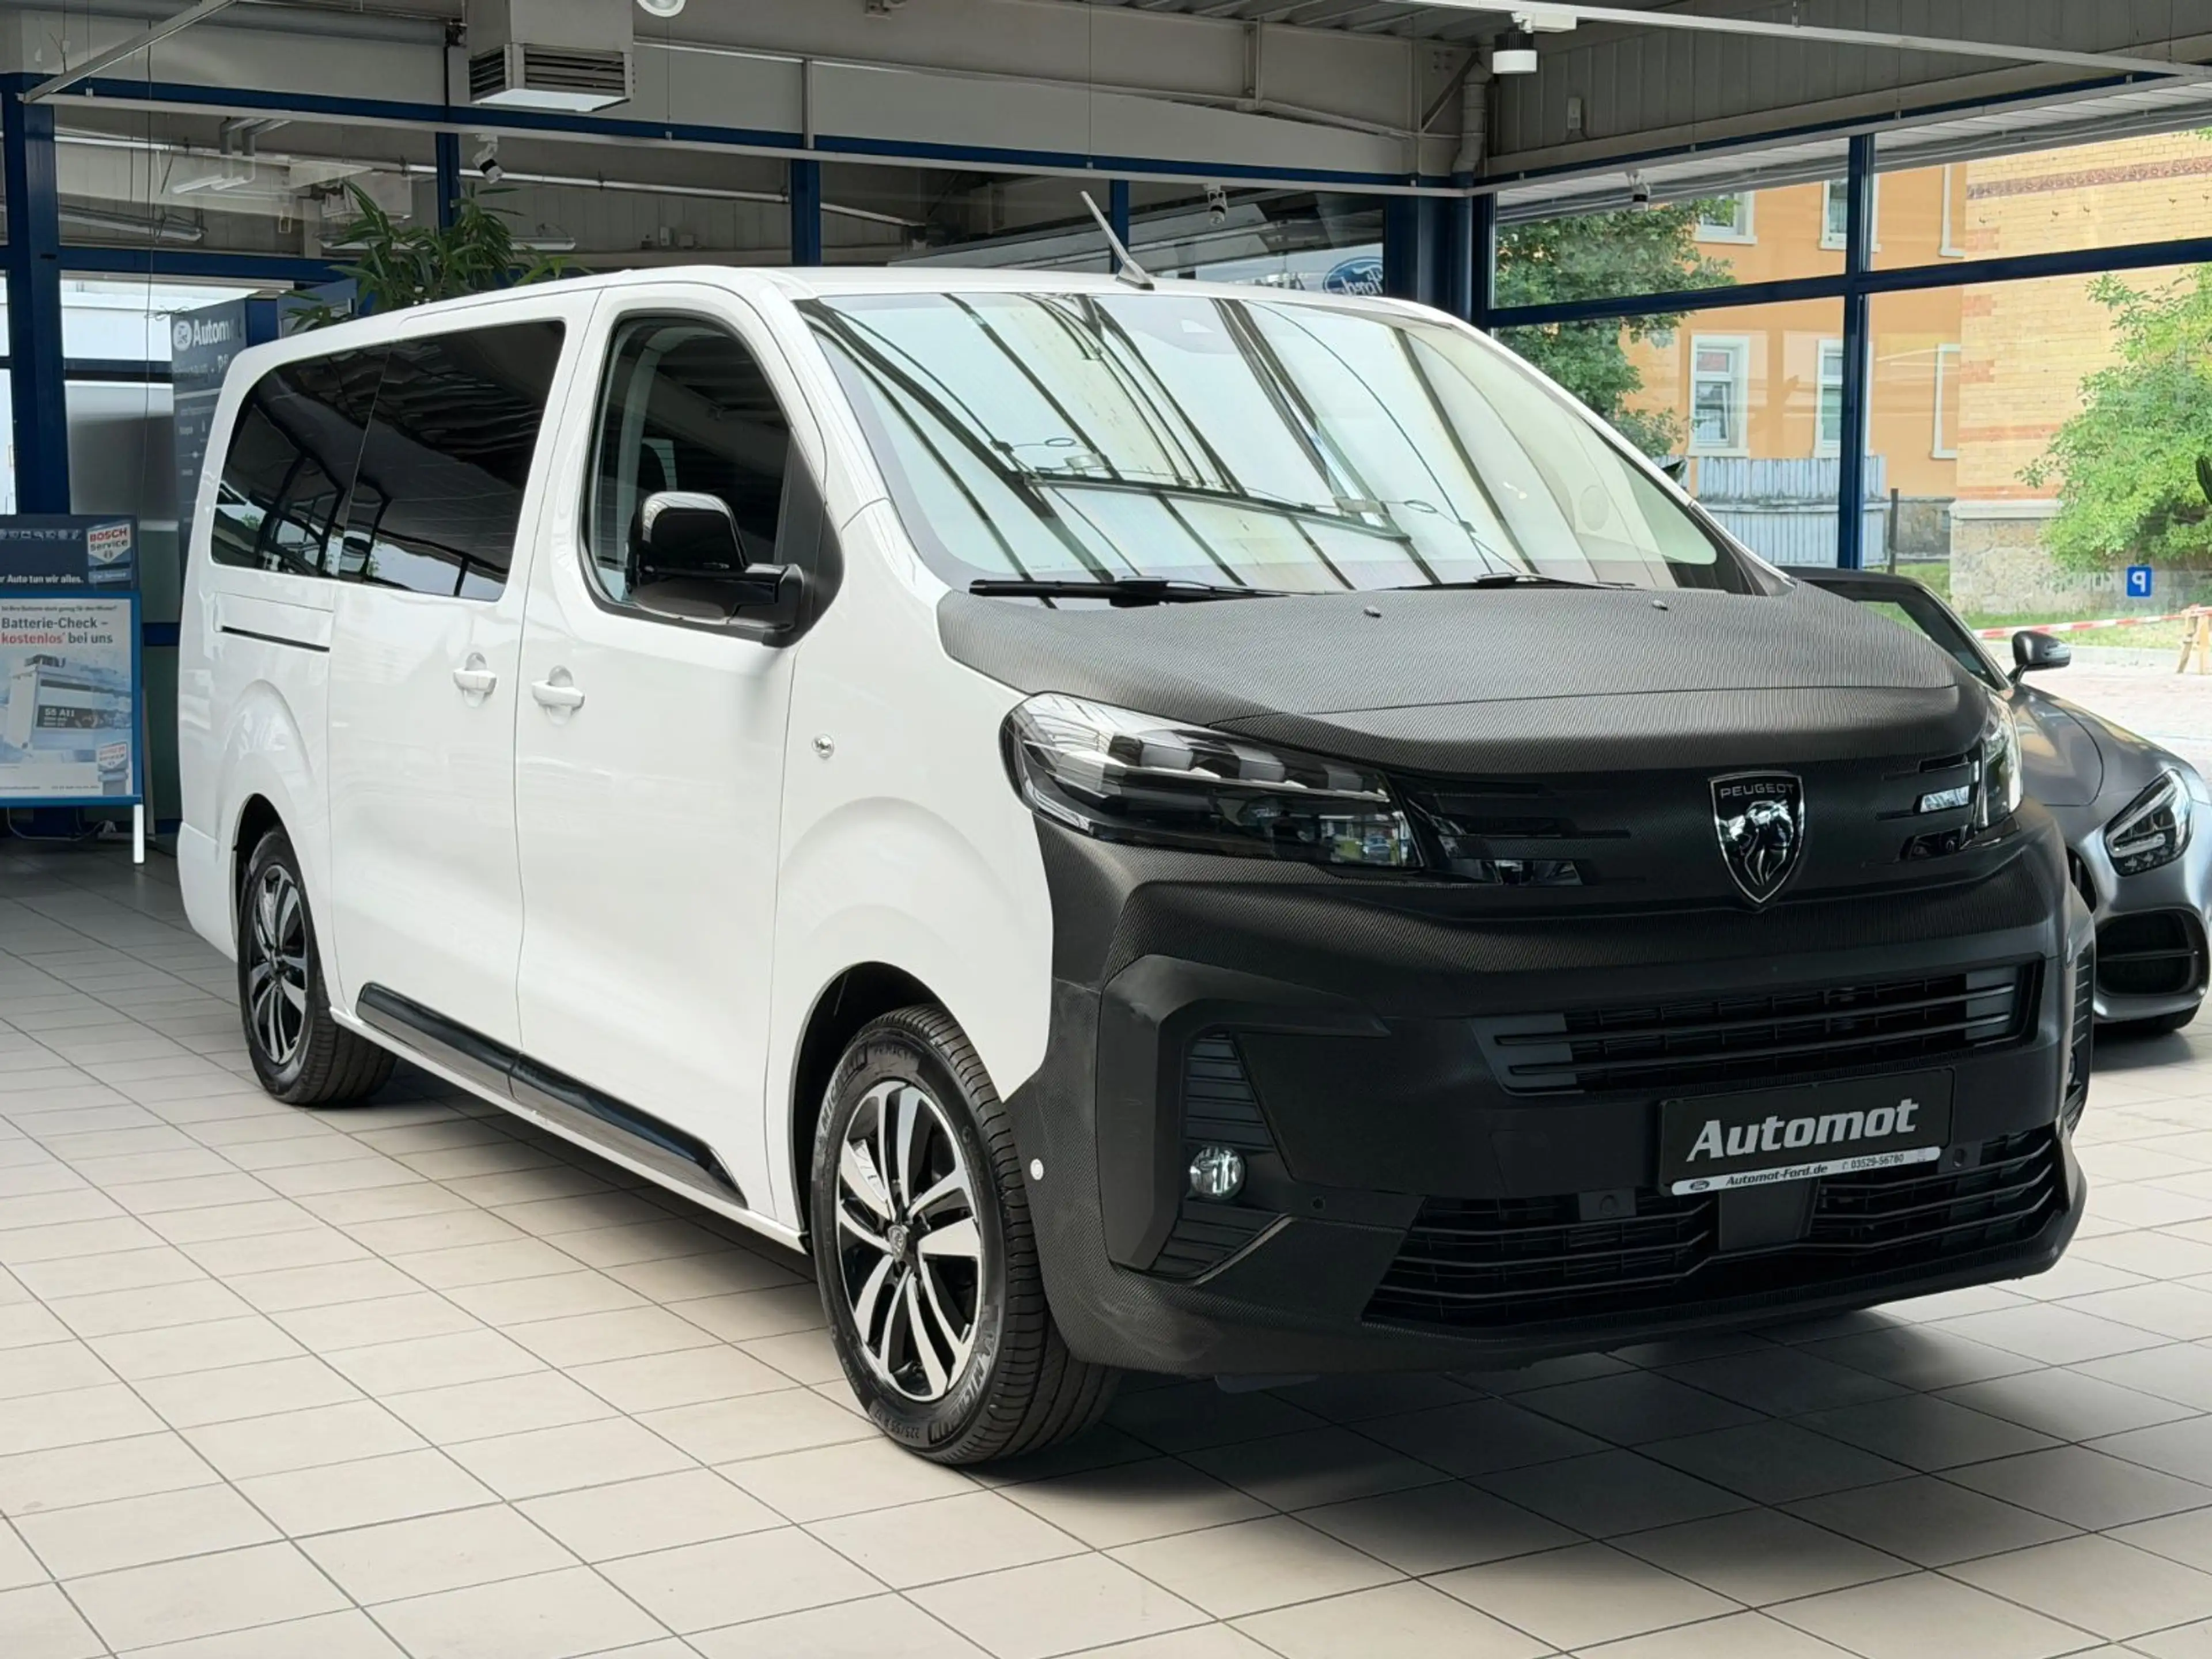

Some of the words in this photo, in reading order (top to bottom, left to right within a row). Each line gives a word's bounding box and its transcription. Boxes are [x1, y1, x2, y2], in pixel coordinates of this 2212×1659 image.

[90, 527, 127, 542] BOSCH
[90, 539, 128, 552] Service
[7, 574, 28, 583] Auto
[29, 574, 44, 583] tun
[46, 574, 59, 583] wir
[60, 574, 84, 583] alles.
[1, 616, 98, 628] Batterie-Check
[68, 631, 88, 644] bei
[90, 634, 113, 644] uns
[1720, 783, 1795, 800] PEUGEOT
[1686, 1097, 1919, 1162] Automot
[1725, 1164, 1828, 1187] Automot-Ford.de
